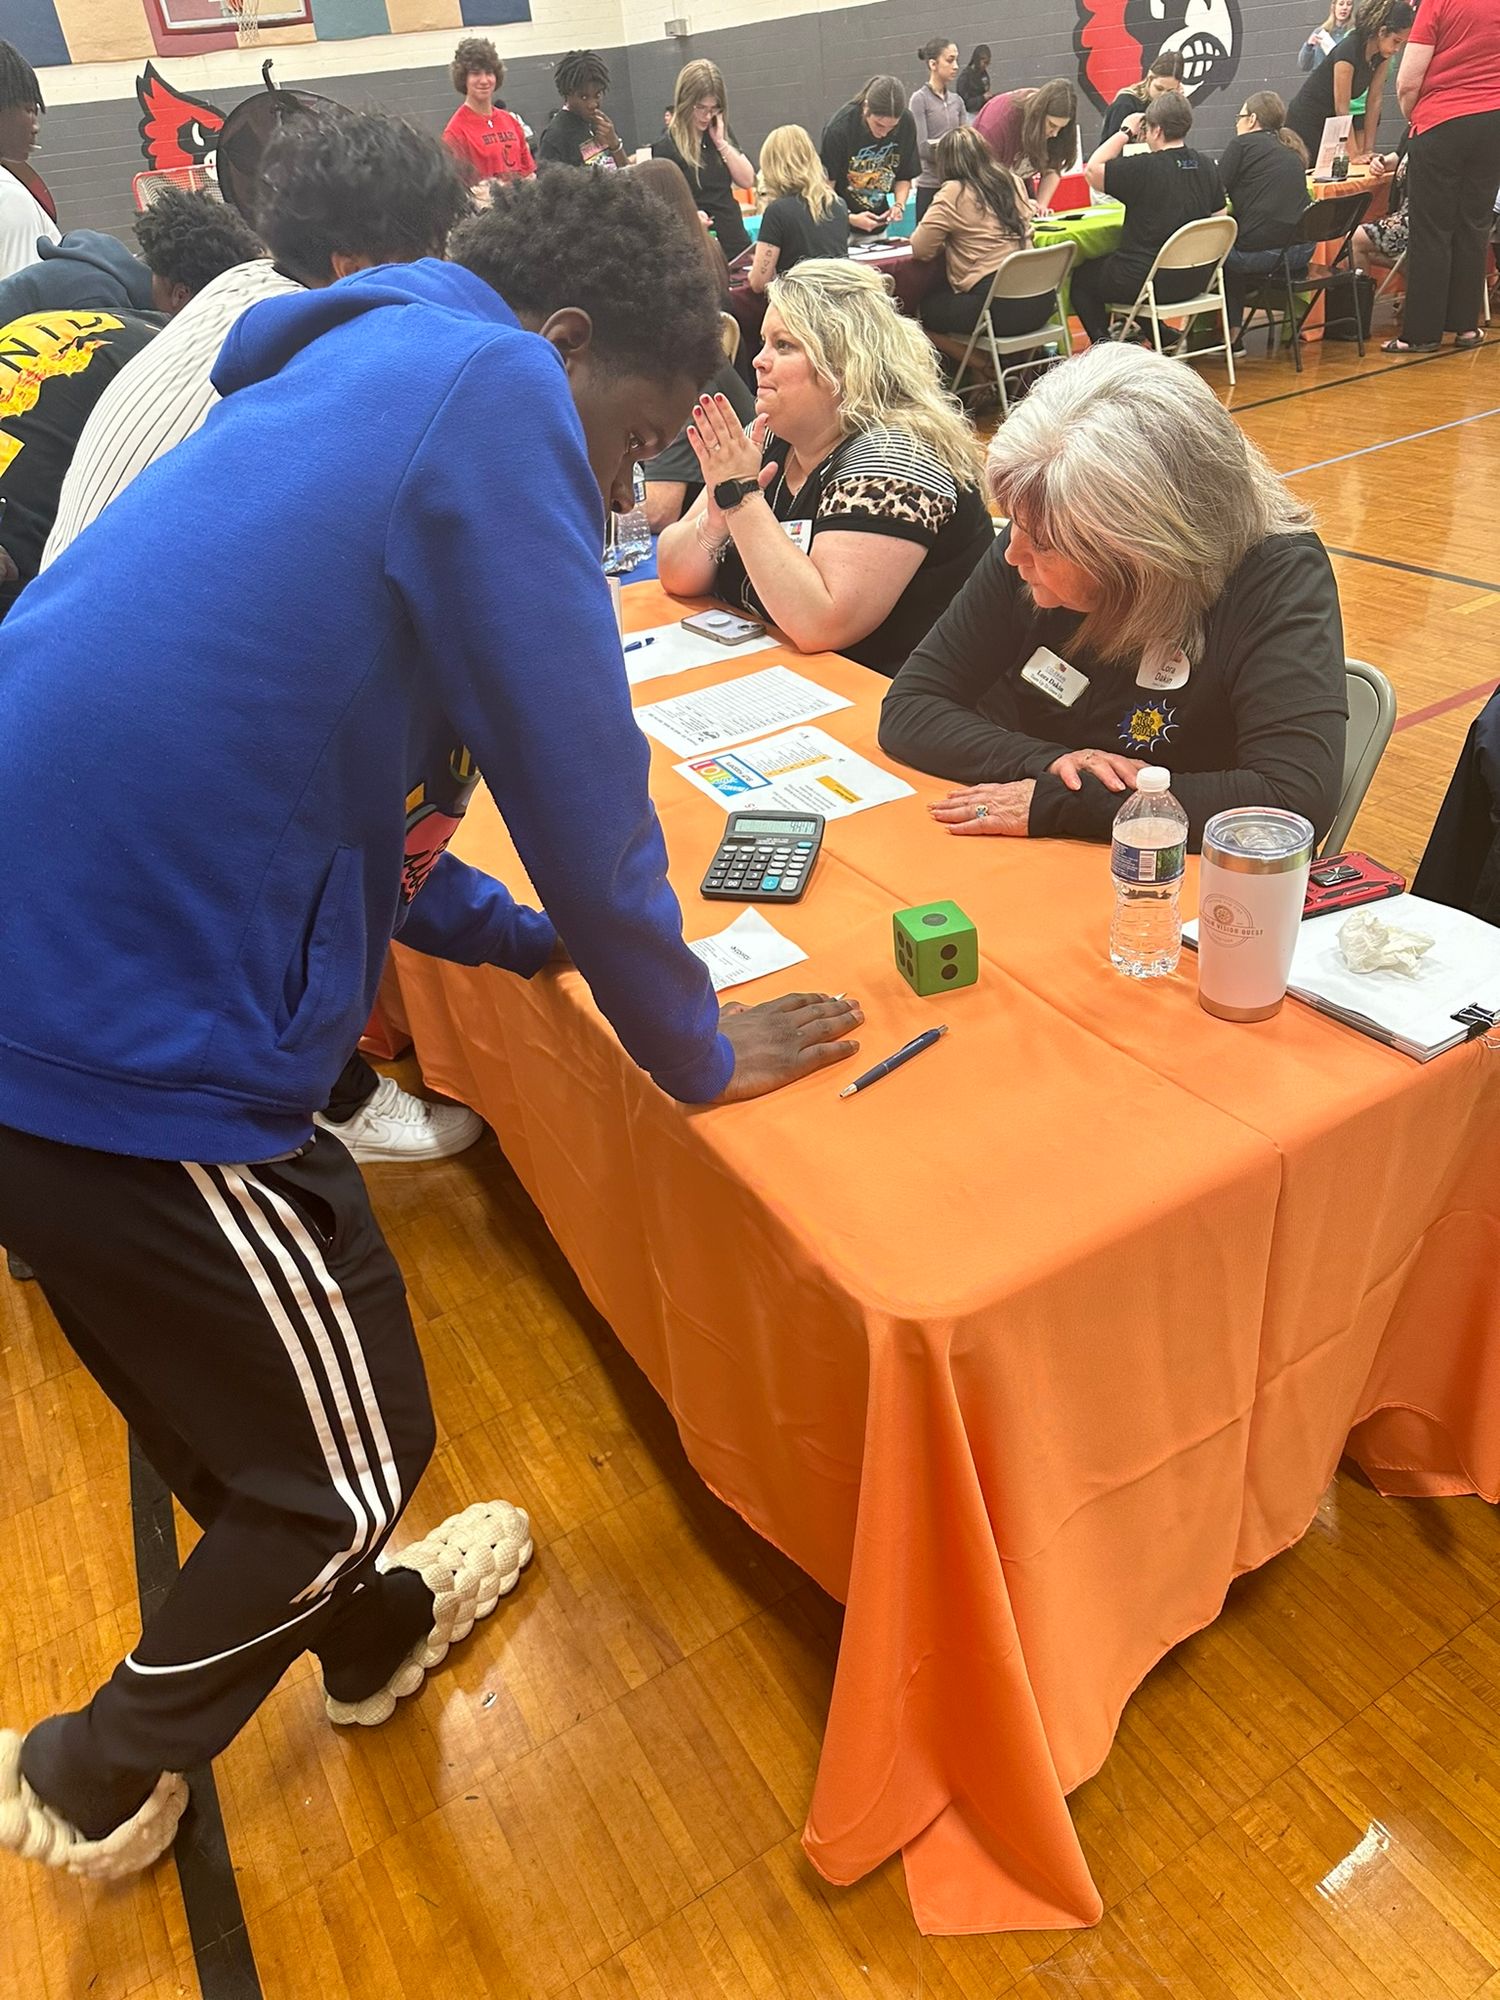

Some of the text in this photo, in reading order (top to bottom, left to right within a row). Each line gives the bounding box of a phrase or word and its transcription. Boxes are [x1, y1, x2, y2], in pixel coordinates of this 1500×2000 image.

[1161, 664, 1176, 674] Lora
[1037, 669, 1048, 681] Lora
[1048, 678, 1064, 693] Dakin
[1155, 672, 1173, 684] Dakin
[1130, 724, 1157, 738] SQUAD
[1217, 924, 1239, 934] VISION
